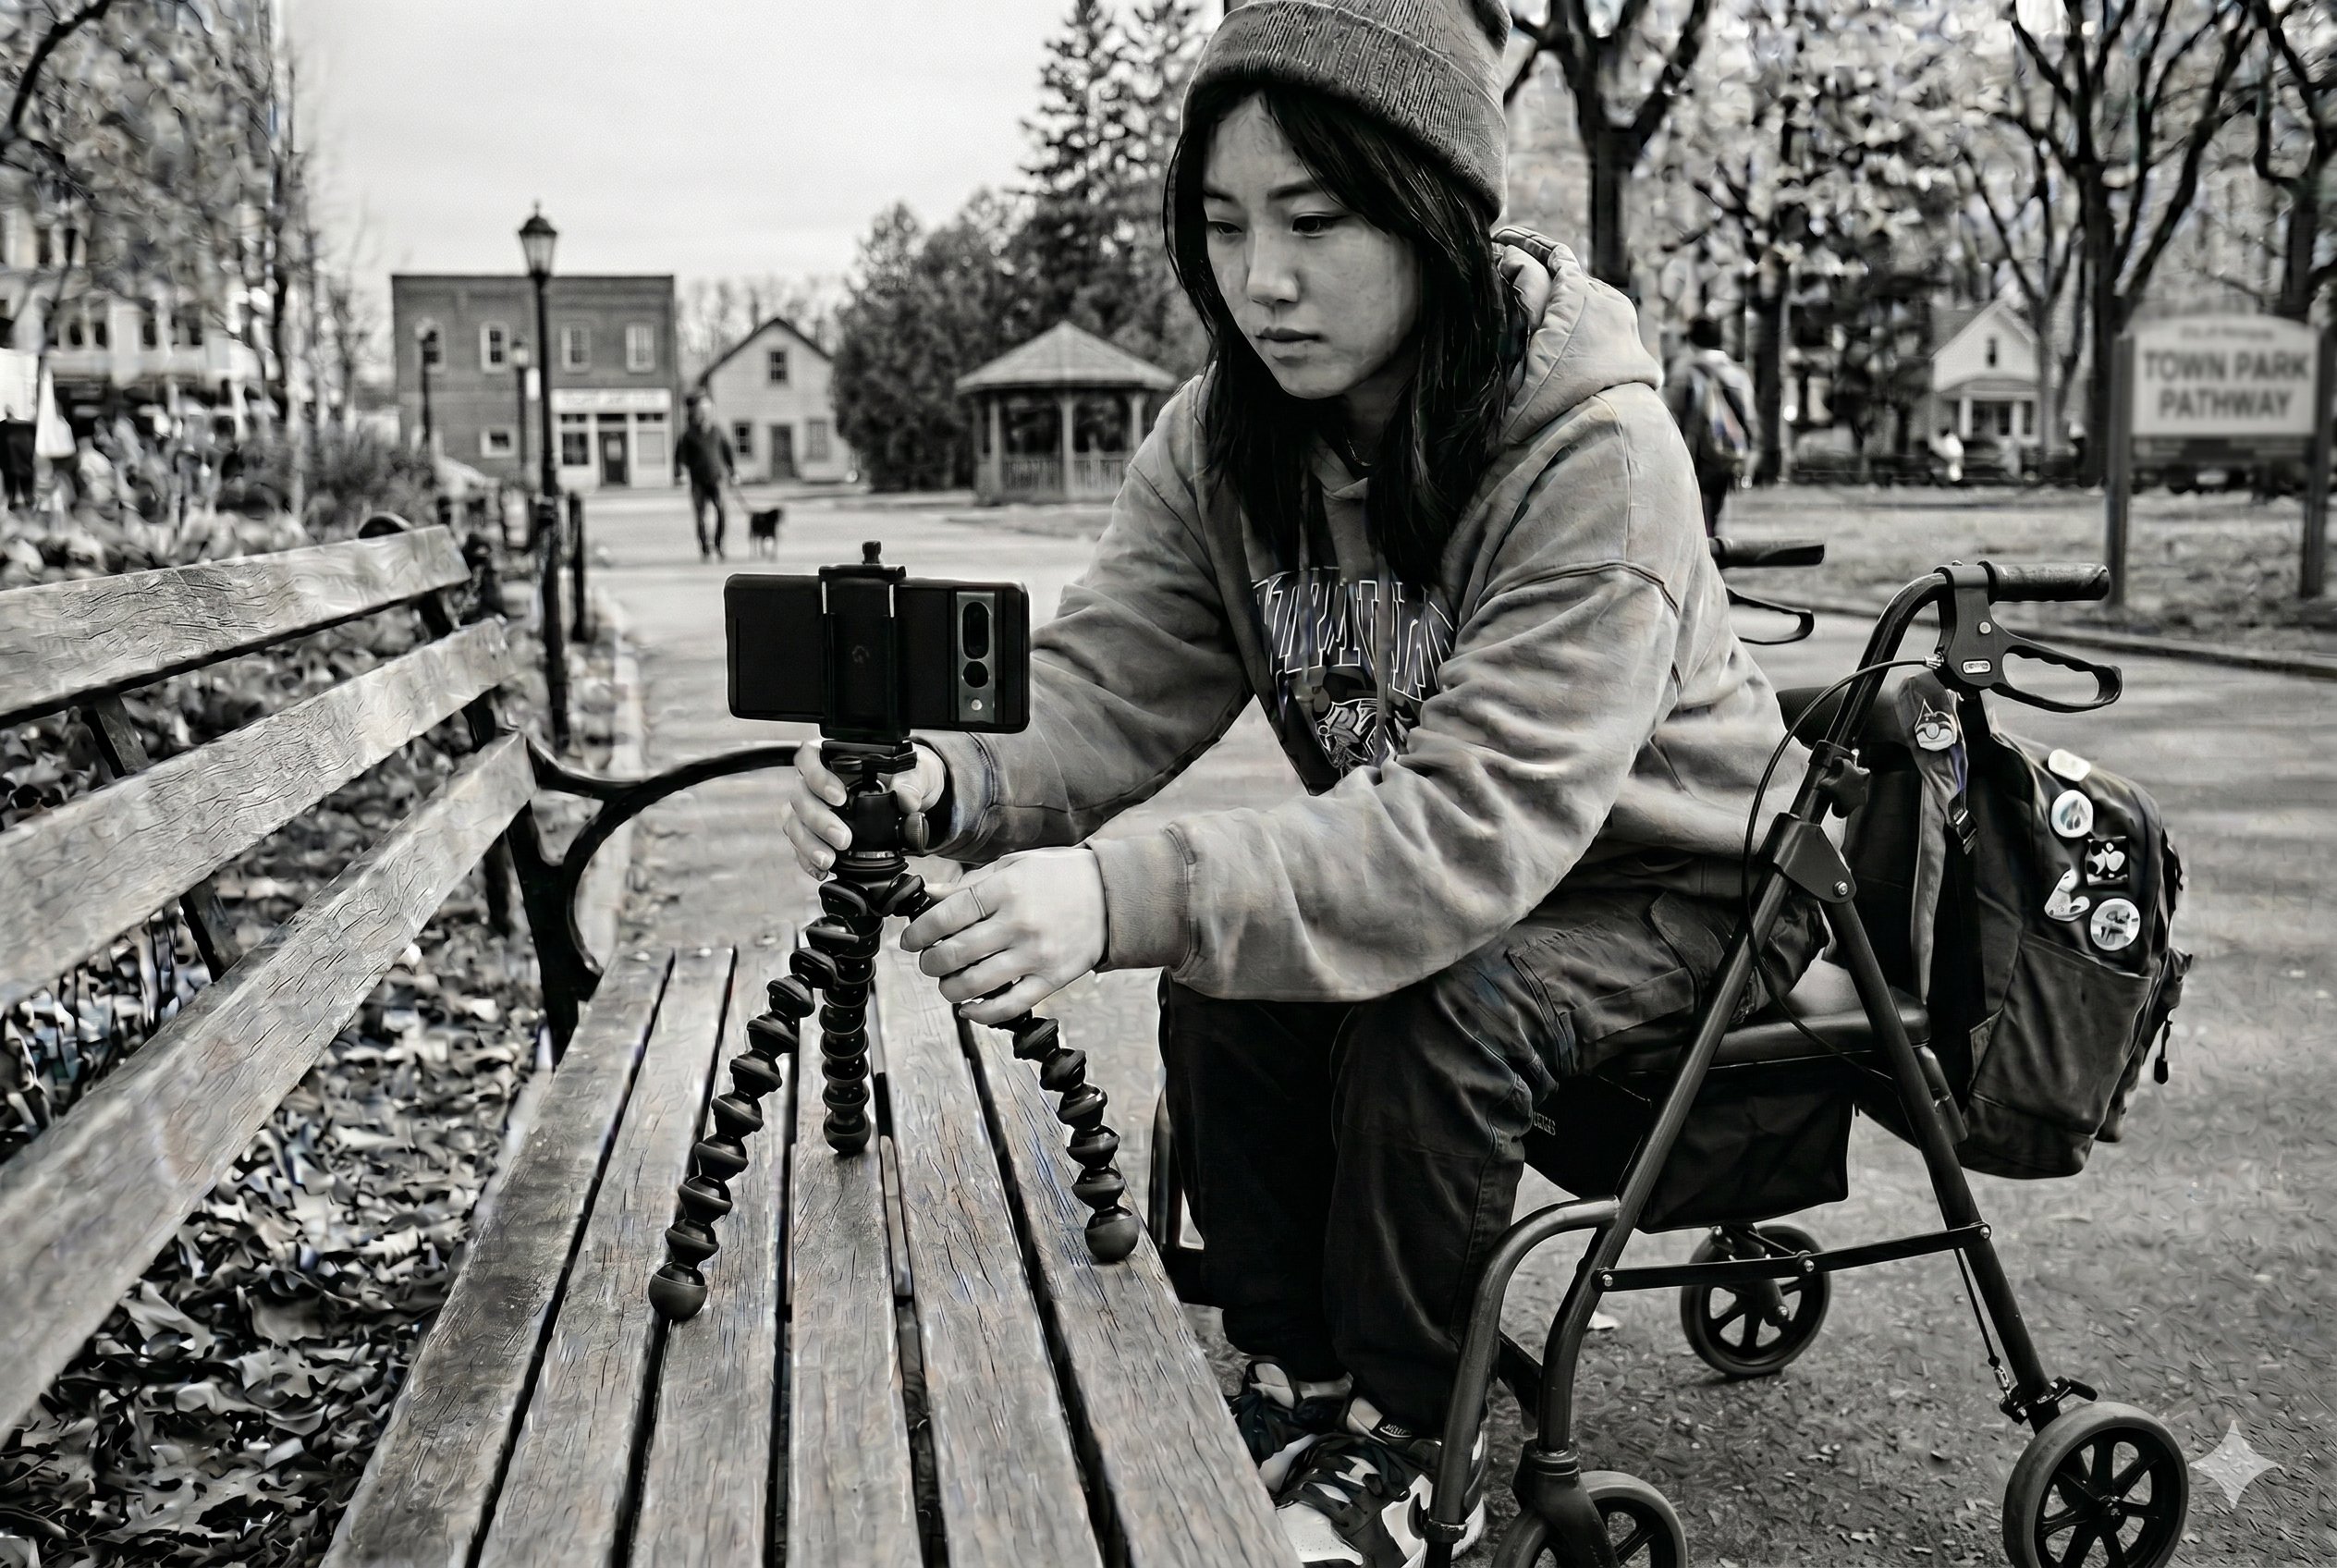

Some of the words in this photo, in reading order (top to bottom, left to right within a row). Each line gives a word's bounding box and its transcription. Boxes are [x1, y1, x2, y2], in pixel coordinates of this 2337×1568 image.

[2144, 350, 2227, 382] TOWN
[2235, 350, 2311, 382] PARK
[2159, 387, 2293, 420] PATHWAY
